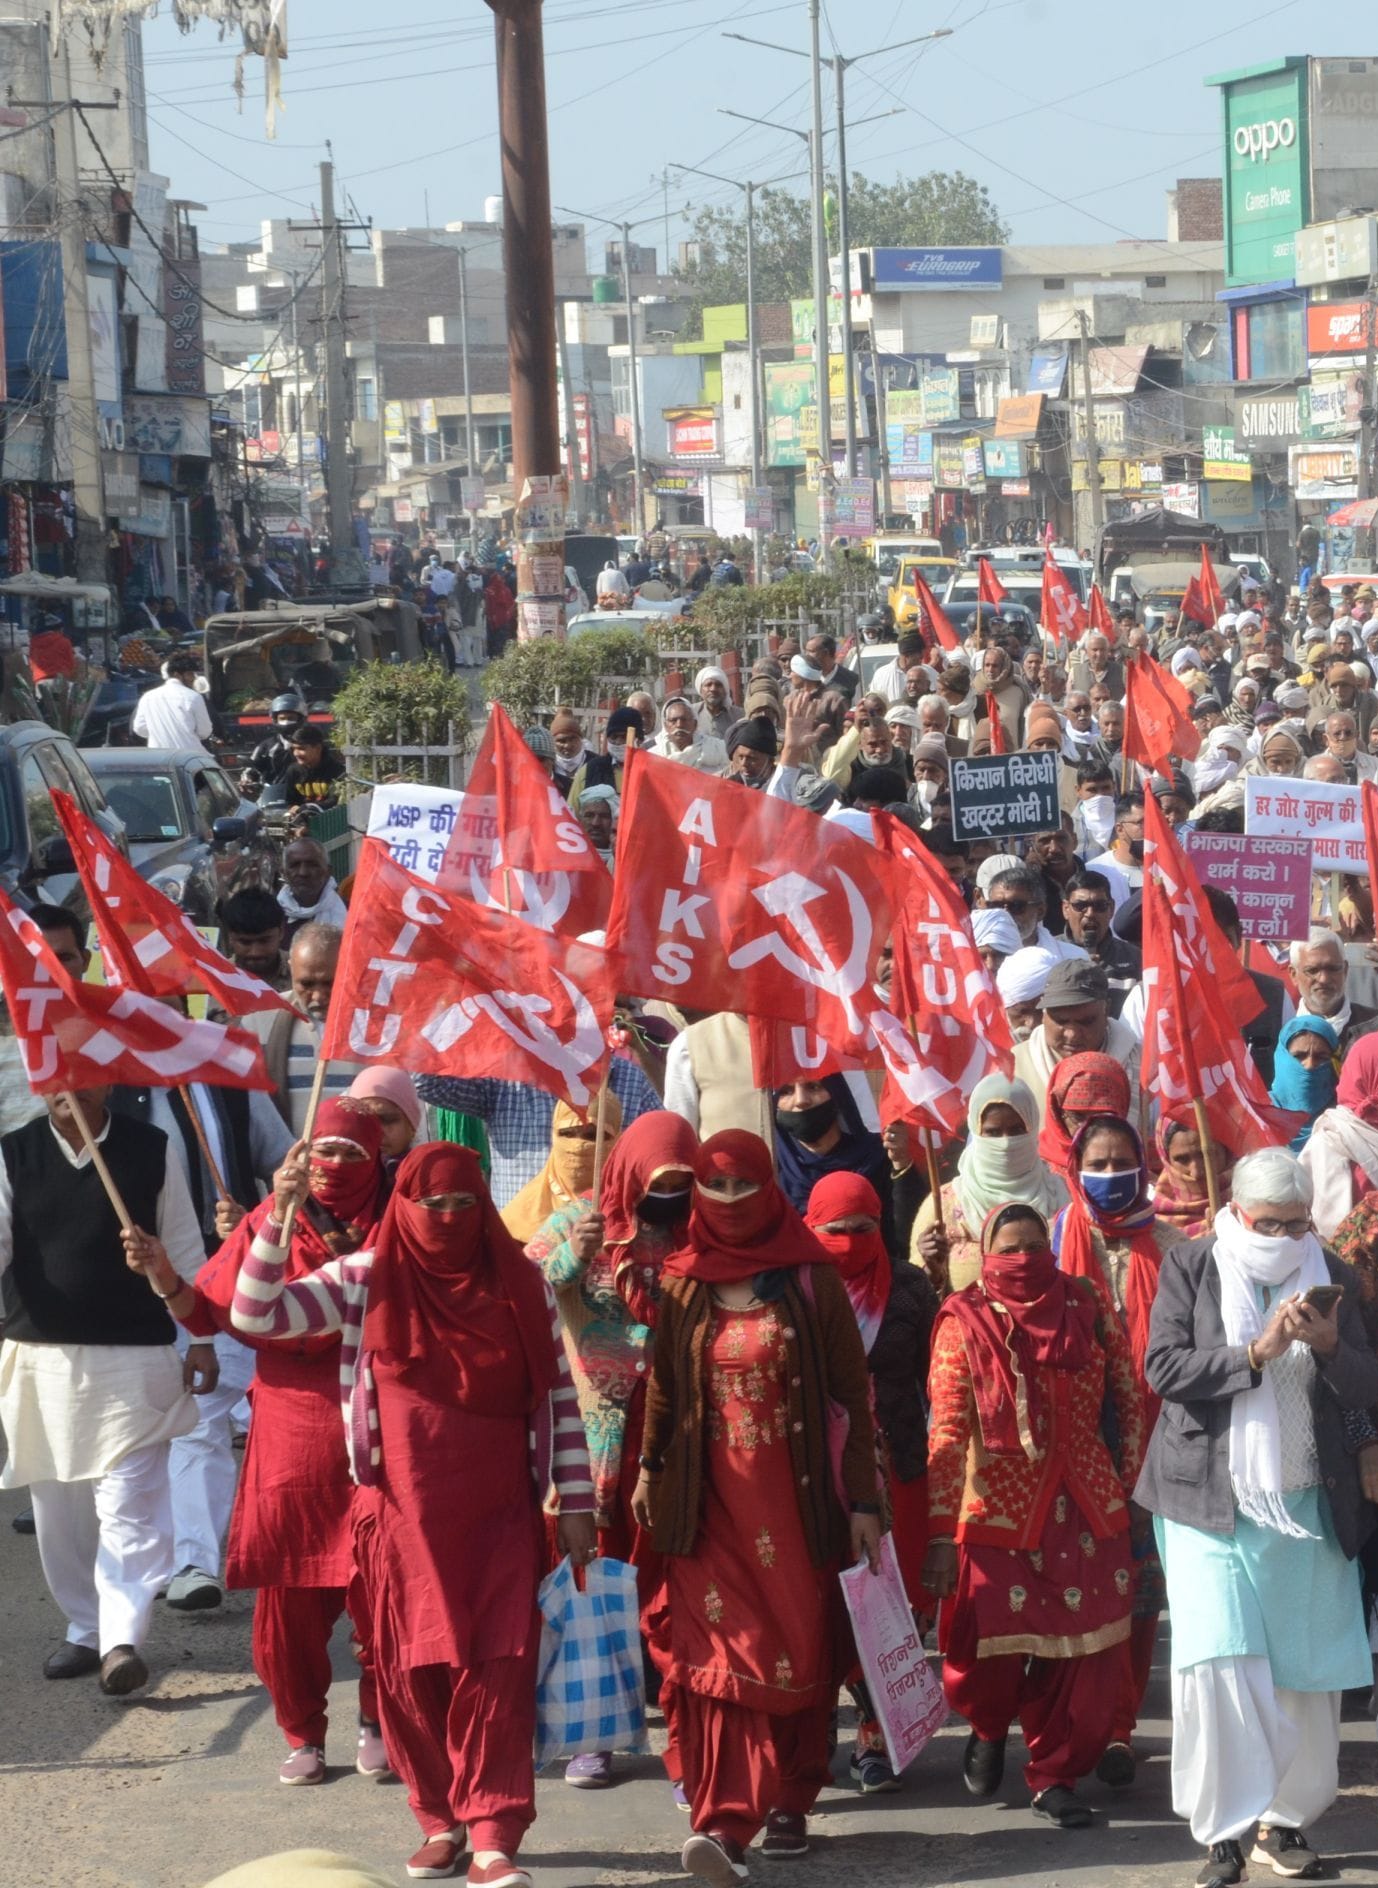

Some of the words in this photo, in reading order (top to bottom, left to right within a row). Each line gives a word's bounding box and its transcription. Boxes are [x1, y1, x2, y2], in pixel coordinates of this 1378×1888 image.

[1234, 117, 1295, 162] oppo
[1245, 190, 1269, 211] Camera
[1270, 186, 1291, 206] Phone
[905, 261, 981, 272] EUROGRIP
[954, 760, 1006, 791] किसान
[1008, 753, 1054, 787] विरोधी
[387, 803, 421, 828] MSP
[428, 803, 457, 834] की
[960, 803, 1005, 835] खट्टर
[1007, 791, 1041, 823] मोदी
[1255, 796, 1270, 816] हर
[1275, 792, 1300, 818] जोर
[1304, 799, 1334, 827] जुल्म
[1338, 798, 1357, 823] की
[1191, 835, 1248, 853] भाजपा
[1250, 838, 1310, 857] सरकार
[1207, 858, 1239, 880] शर्म
[1242, 861, 1276, 881] करो
[651, 797, 718, 986] AIKS
[1242, 892, 1296, 919] कानून
[348, 886, 452, 1057] CITU
